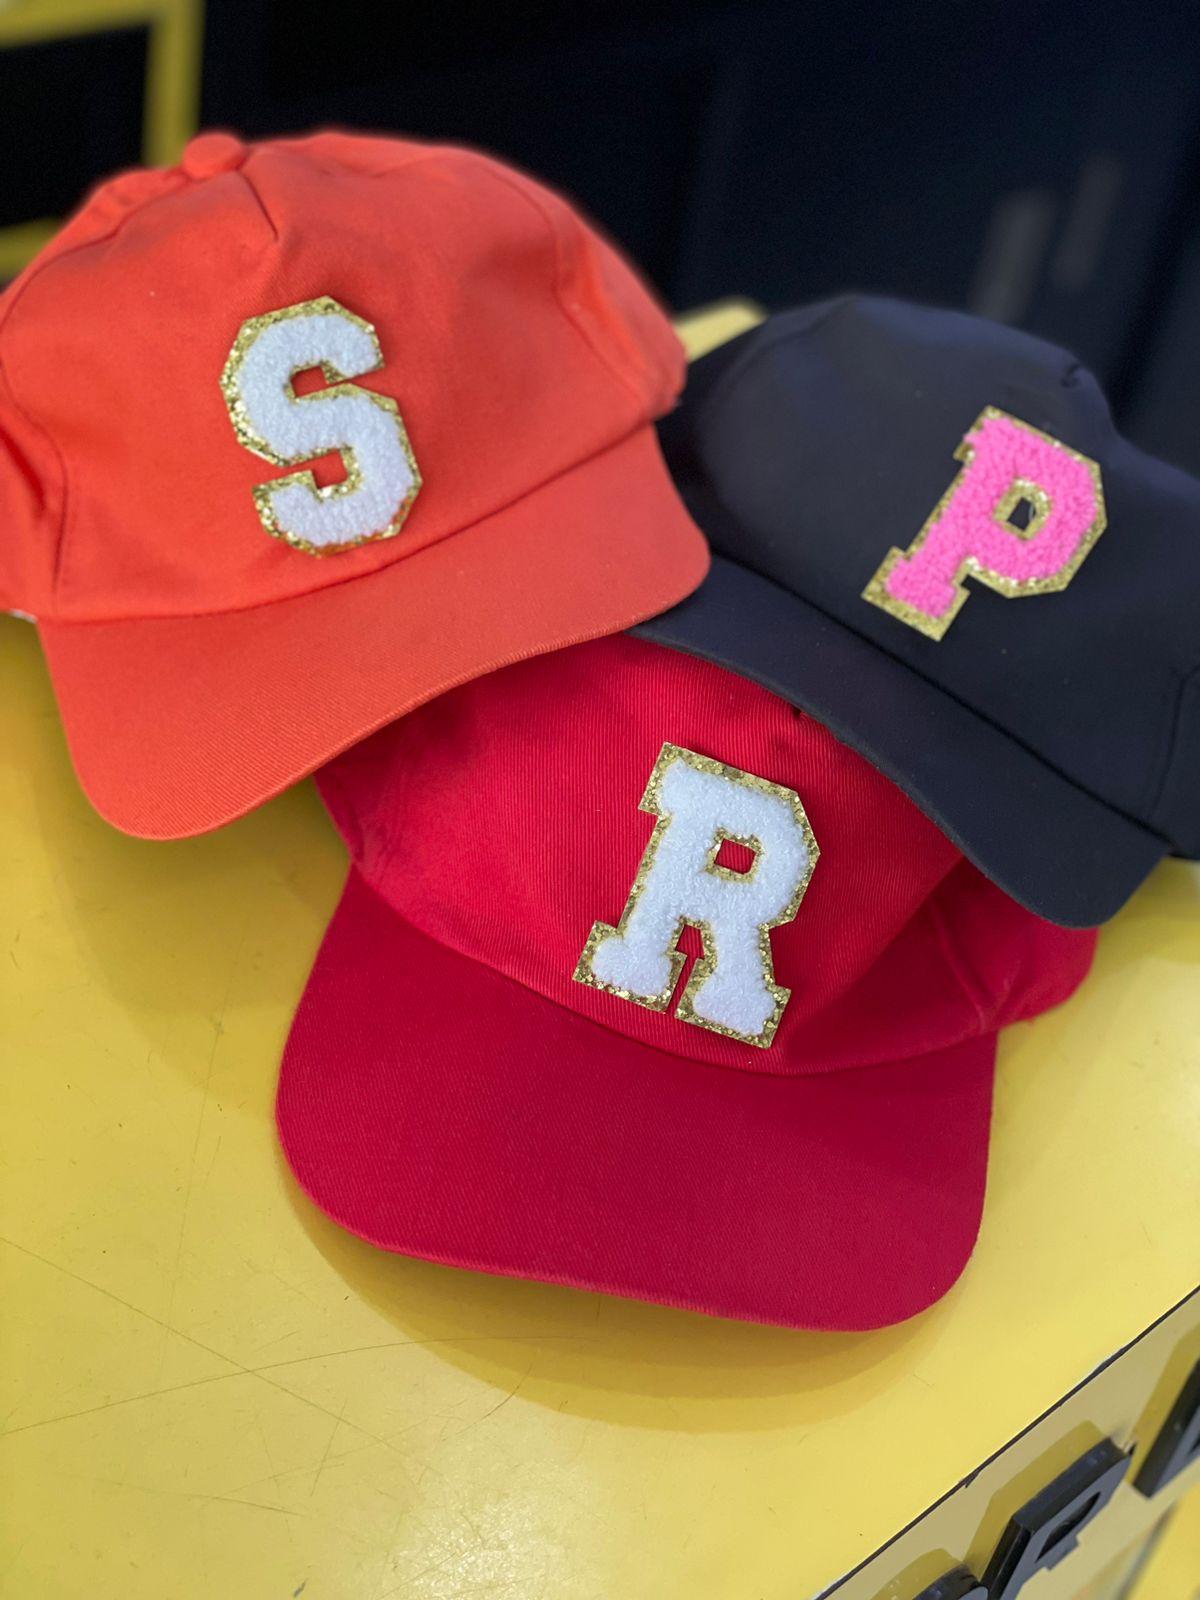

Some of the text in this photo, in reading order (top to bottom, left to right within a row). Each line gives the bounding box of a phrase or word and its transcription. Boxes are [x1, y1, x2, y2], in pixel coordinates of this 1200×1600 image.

[219, 295, 423, 556] S
[861, 405, 1108, 641] P
[572, 741, 821, 1048] R
